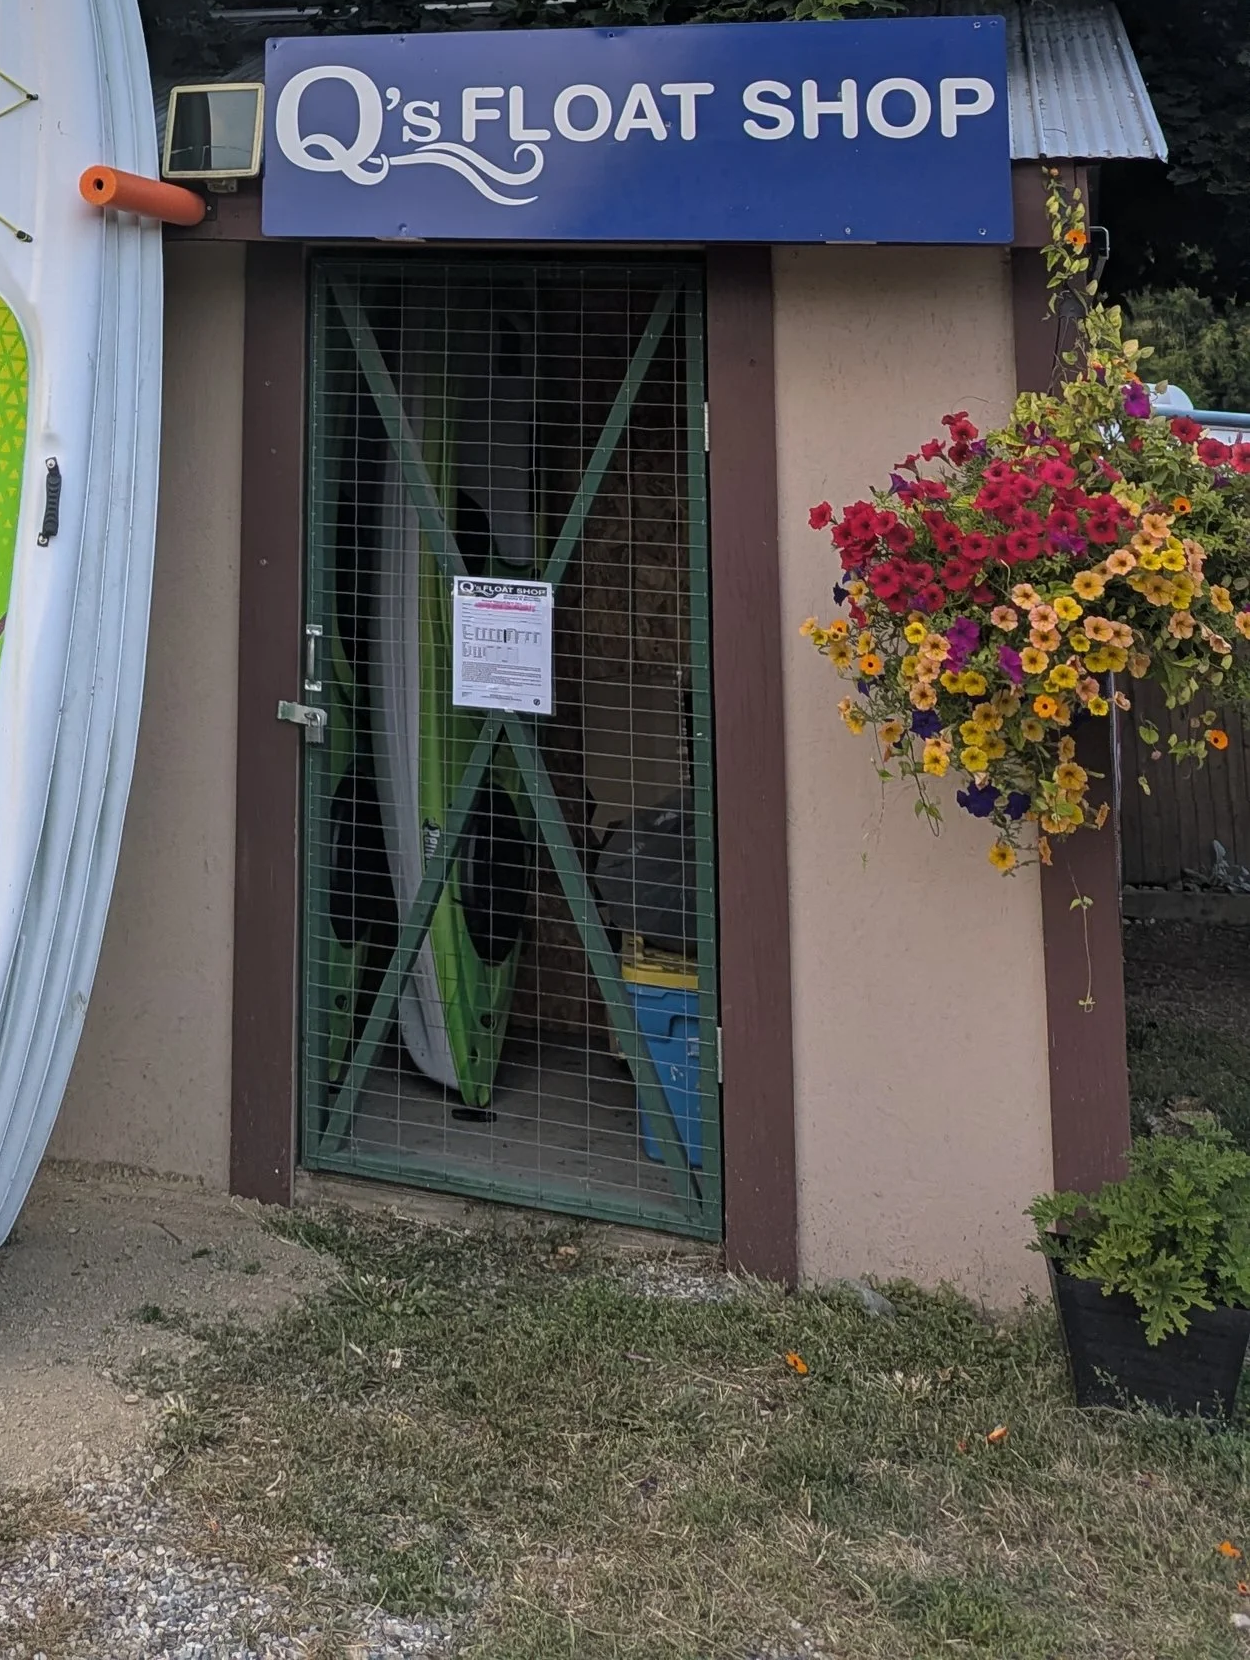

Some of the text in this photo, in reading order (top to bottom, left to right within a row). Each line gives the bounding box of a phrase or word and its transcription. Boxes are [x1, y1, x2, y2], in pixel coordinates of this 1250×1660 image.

[275, 65, 995, 185] Q's FLOAT SHOP
[483, 585, 515, 593] FLOAT
